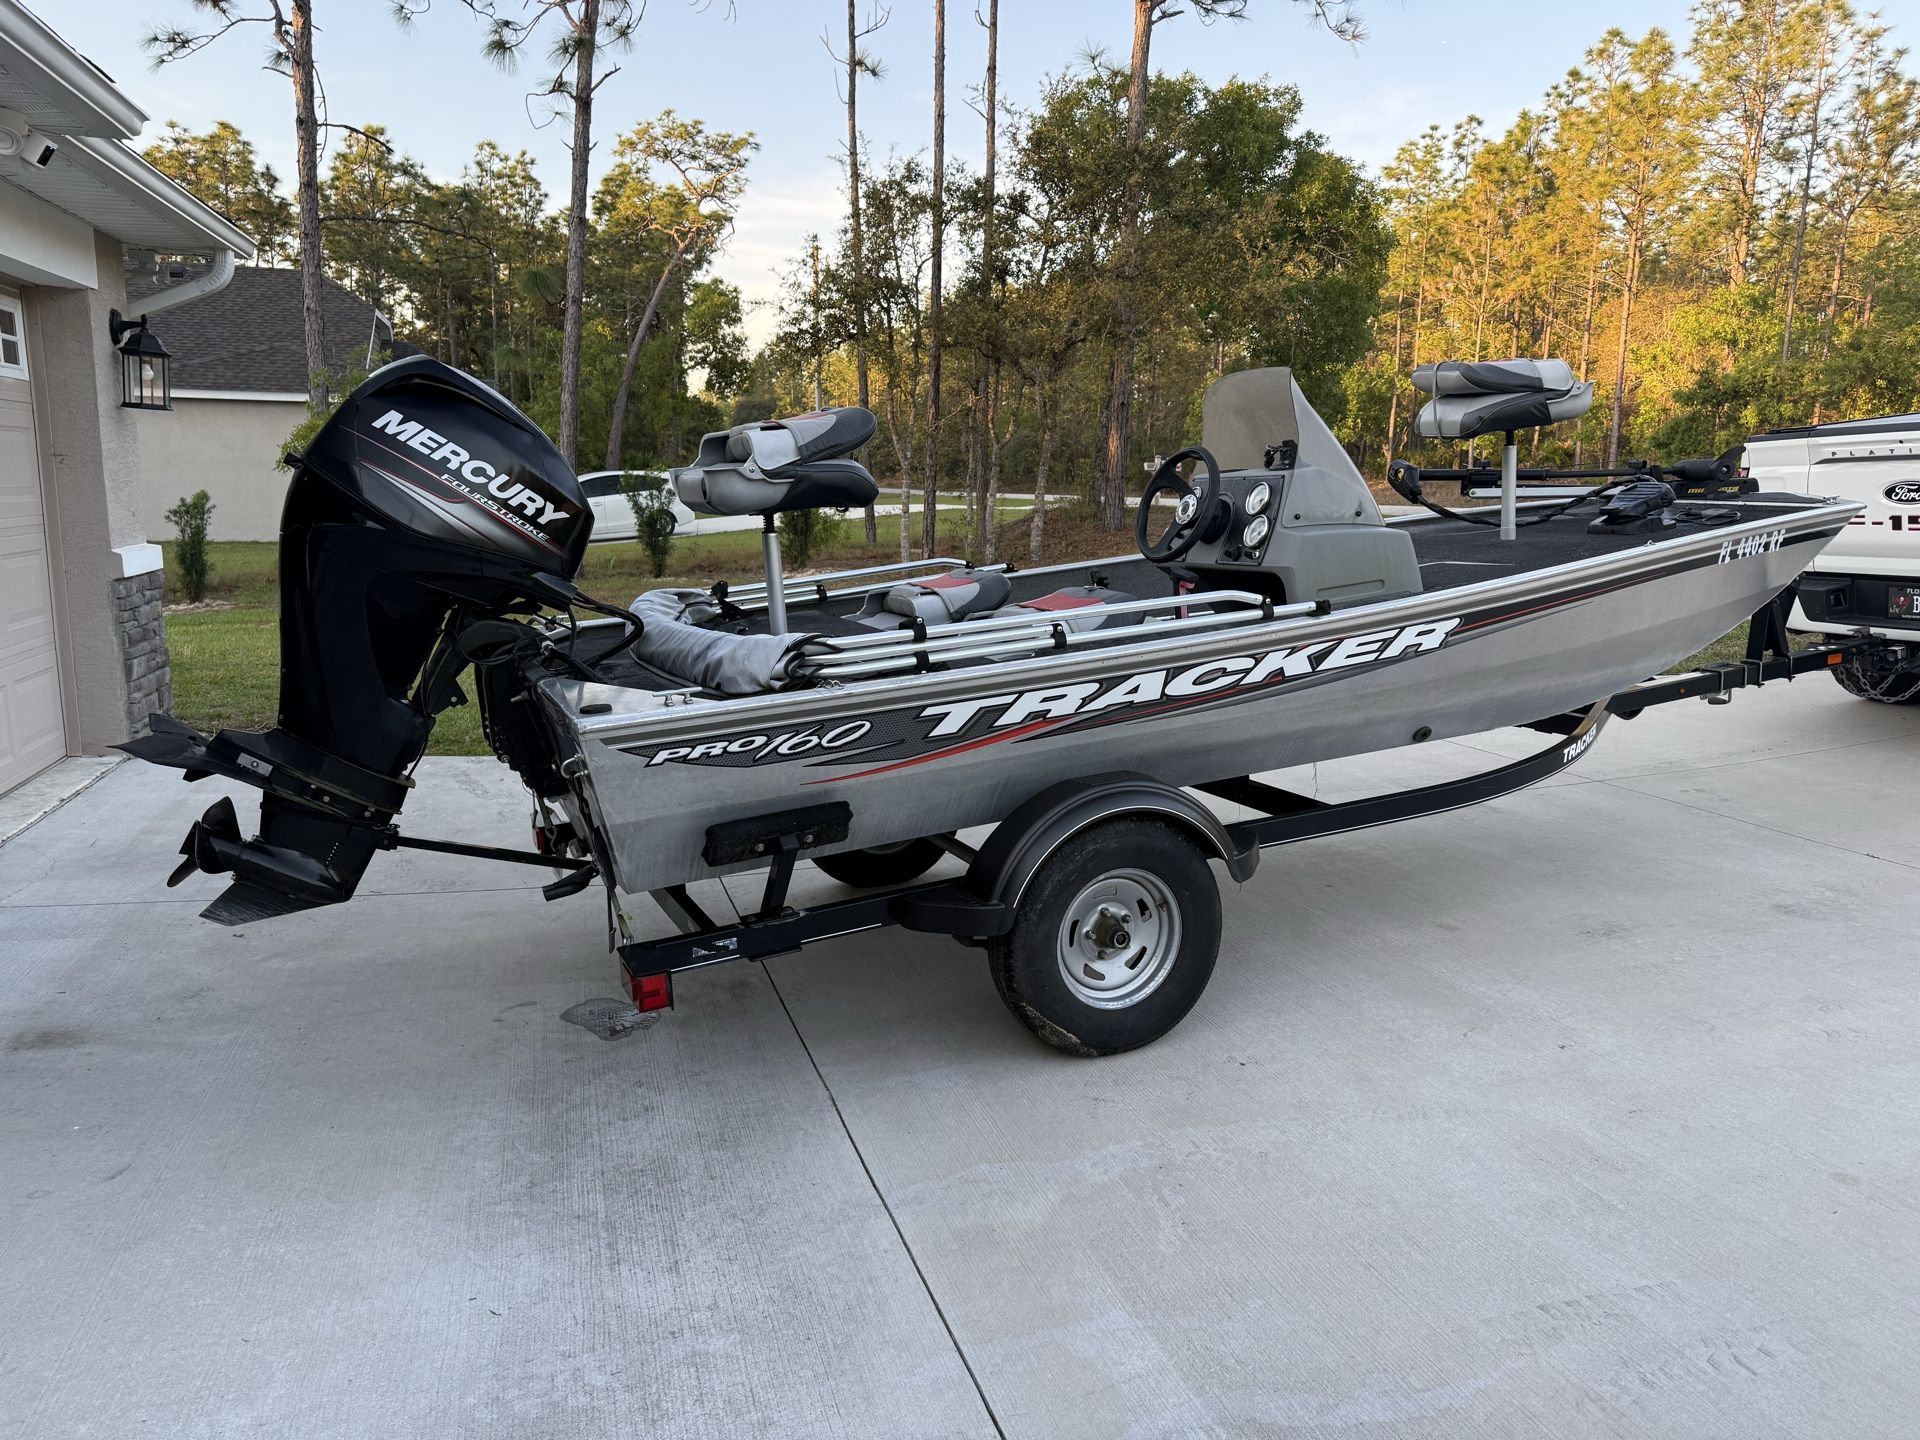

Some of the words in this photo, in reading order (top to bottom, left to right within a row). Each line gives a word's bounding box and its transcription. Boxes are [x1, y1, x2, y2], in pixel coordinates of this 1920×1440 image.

[371, 409, 570, 525] MERCURY
[440, 473, 550, 541] FOURSTROKE
[1718, 541, 1732, 565] FL
[1737, 533, 1767, 559] 4402
[920, 617, 1463, 737] TRACKER
[1563, 723, 1597, 763] TRACKER
